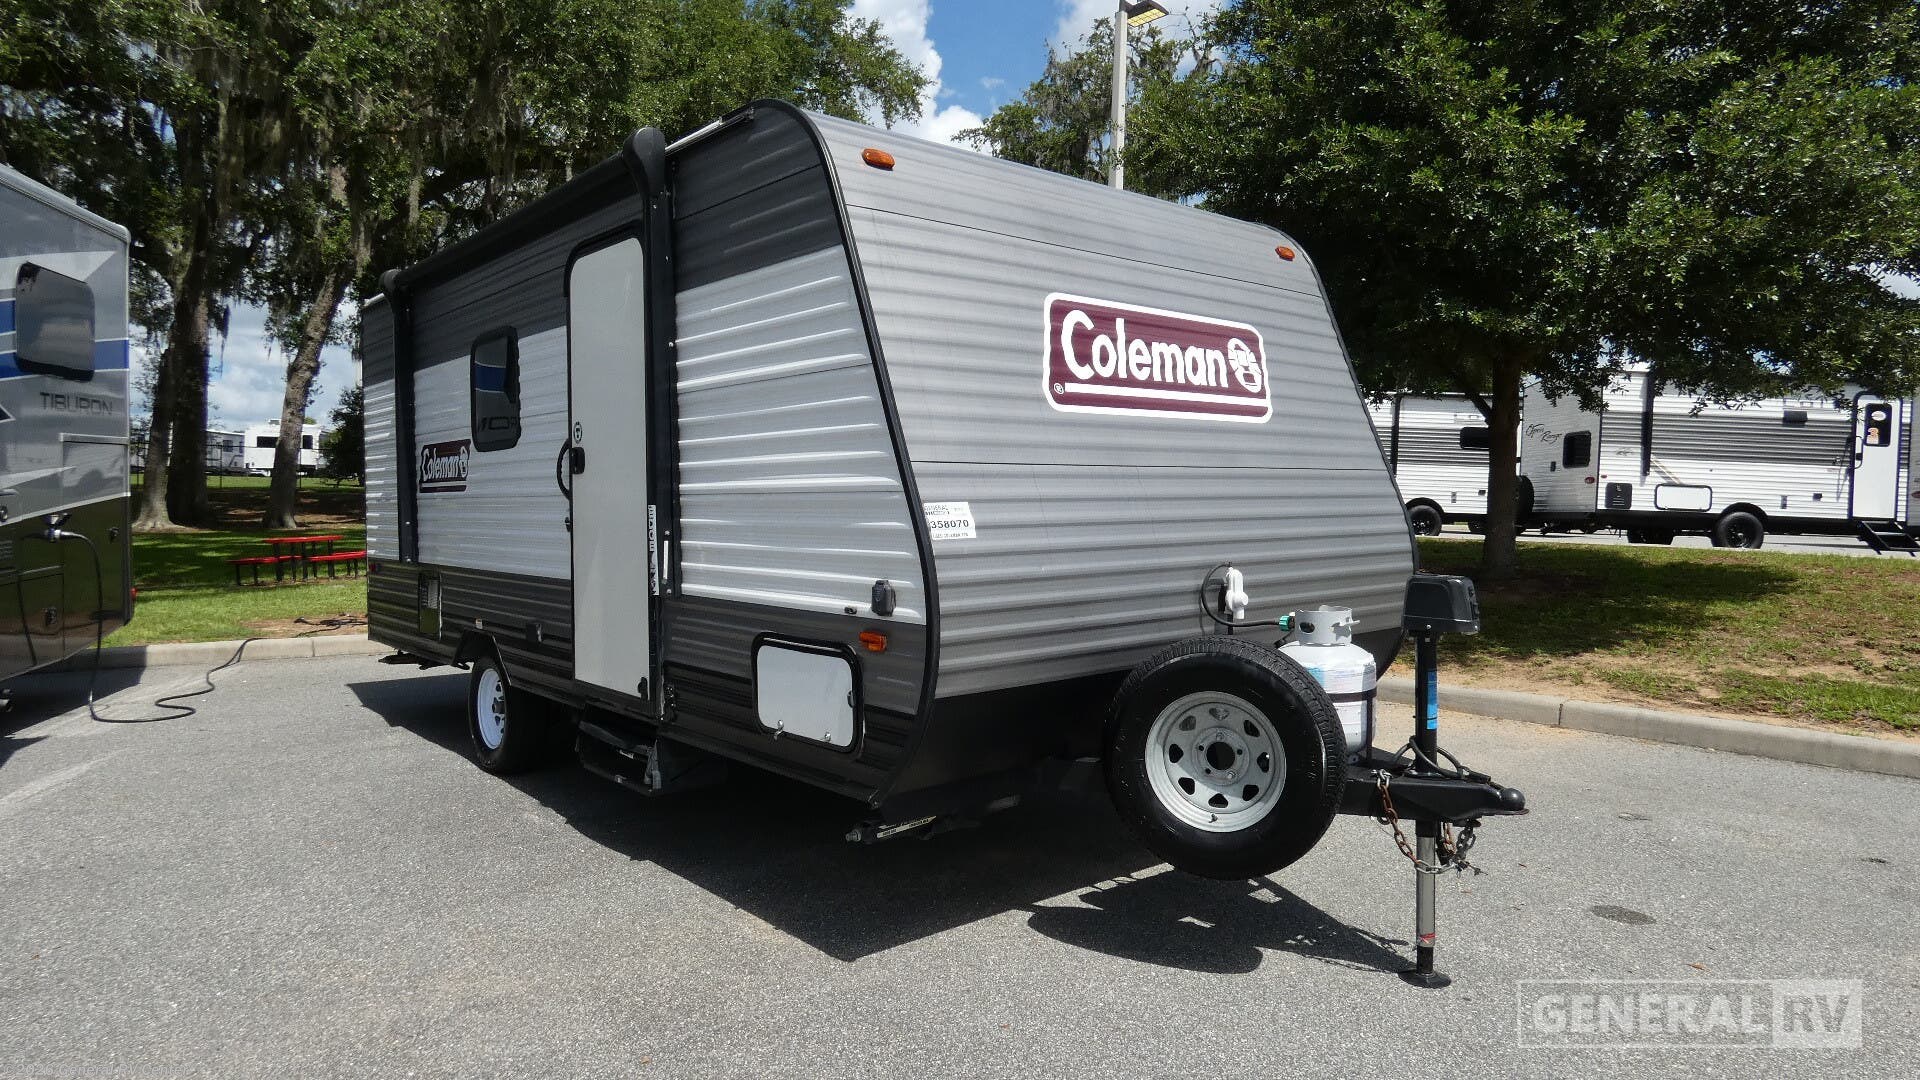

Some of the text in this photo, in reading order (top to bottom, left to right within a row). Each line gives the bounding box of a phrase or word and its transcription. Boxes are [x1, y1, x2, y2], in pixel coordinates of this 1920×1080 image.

[1061, 310, 1229, 388] Coleman
[40, 392, 113, 415] TIBURON
[422, 448, 459, 481] Coleman
